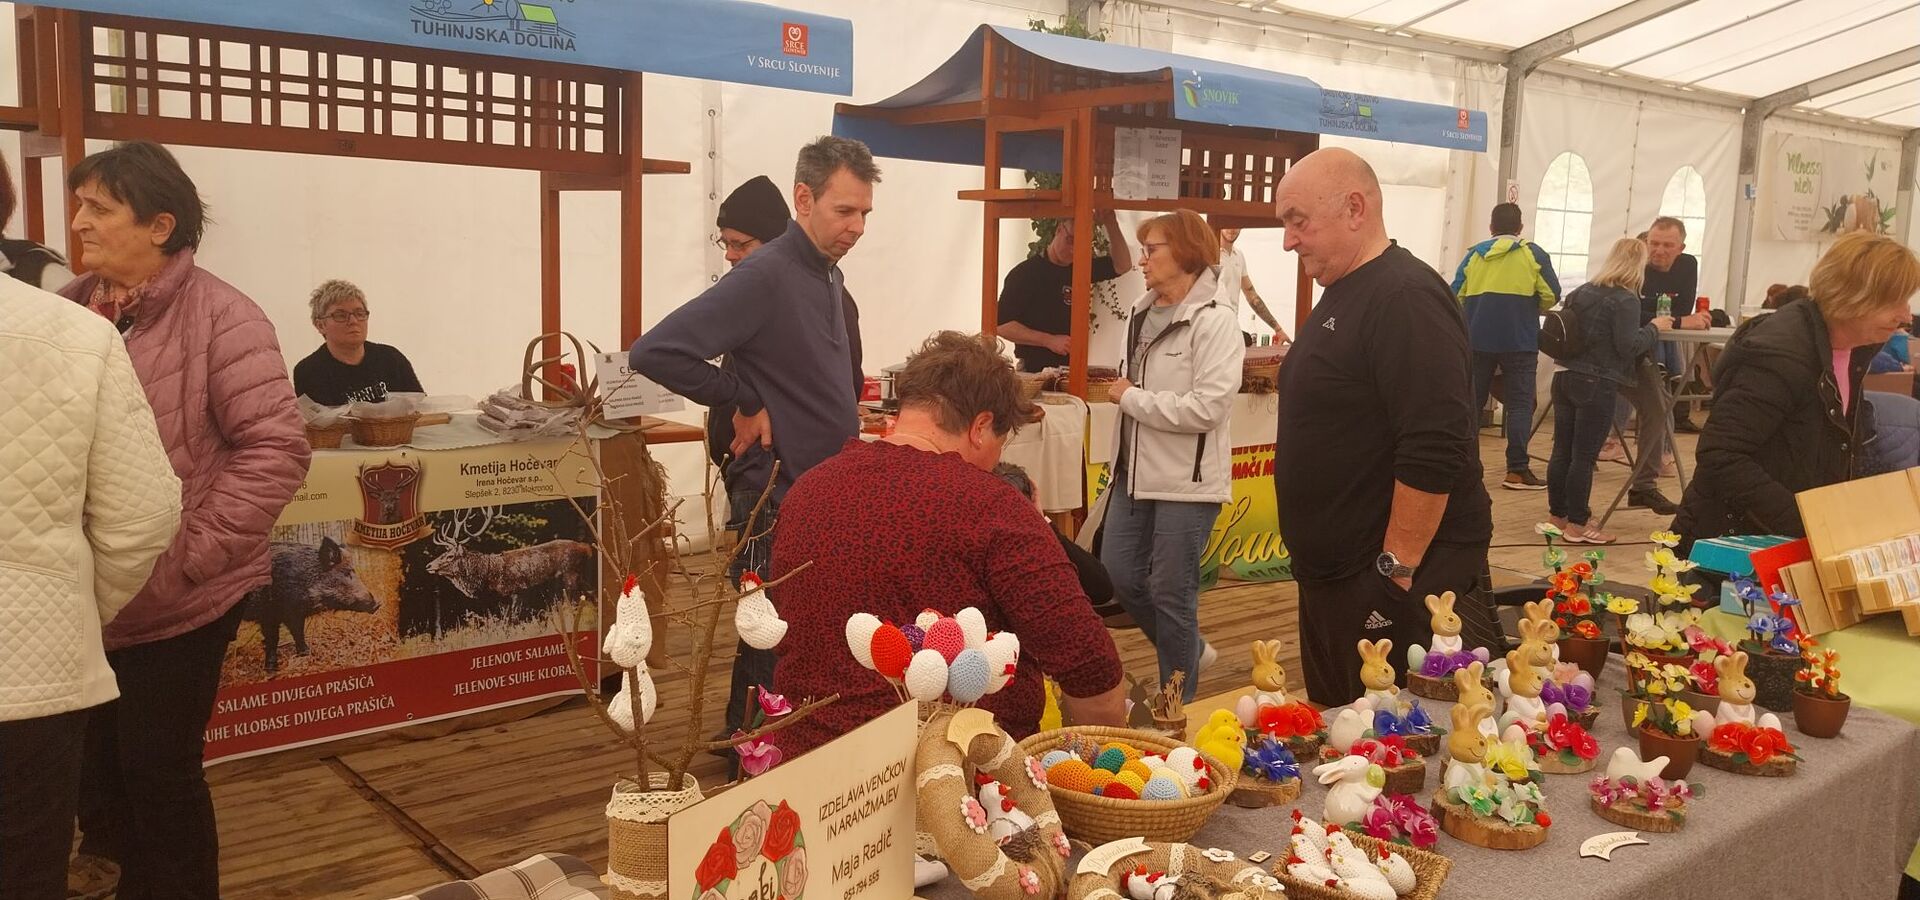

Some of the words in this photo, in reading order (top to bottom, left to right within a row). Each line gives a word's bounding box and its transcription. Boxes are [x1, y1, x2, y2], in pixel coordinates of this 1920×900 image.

[410, 19, 510, 44] TUHINJSKA
[515, 32, 576, 51] DOLINA
[785, 40, 805, 50] SRCE
[747, 55, 755, 67] V
[1203, 88, 1239, 105] SNOVIK
[1319, 118, 1353, 130] TUHINJSKA
[460, 461, 506, 476] Kmetija
[510, 459, 558, 472] Hočevar
[476, 478, 495, 487] Irena
[497, 475, 526, 485] Hočevar
[465, 489, 492, 499] Slepšek
[354, 519, 387, 539] KMETIJA
[389, 516, 425, 538] HOČEVAR
[1364, 619, 1393, 630] adidas
[470, 650, 523, 671] JELENOVE
[525, 642, 567, 661] SALAME
[452, 676, 506, 697] JELENOVE
[508, 670, 536, 686] SUHE
[538, 662, 584, 680] KLOBA
[217, 694, 269, 714] SALAME
[272, 683, 323, 705] DIVJEGA
[326, 673, 375, 695] PRAŠIČA
[203, 724, 231, 743] UHE
[234, 715, 290, 737] KLOBASE
[294, 706, 344, 726] DIVJEGA
[347, 694, 395, 716] PRAŠIČA
[819, 783, 865, 822] IZDELAVA
[866, 757, 907, 793] VENČKOV
[826, 822, 837, 842] IN
[838, 783, 899, 835] ARANŽMAJEV
[831, 854, 860, 885] Maja
[862, 826, 892, 865] Radič
